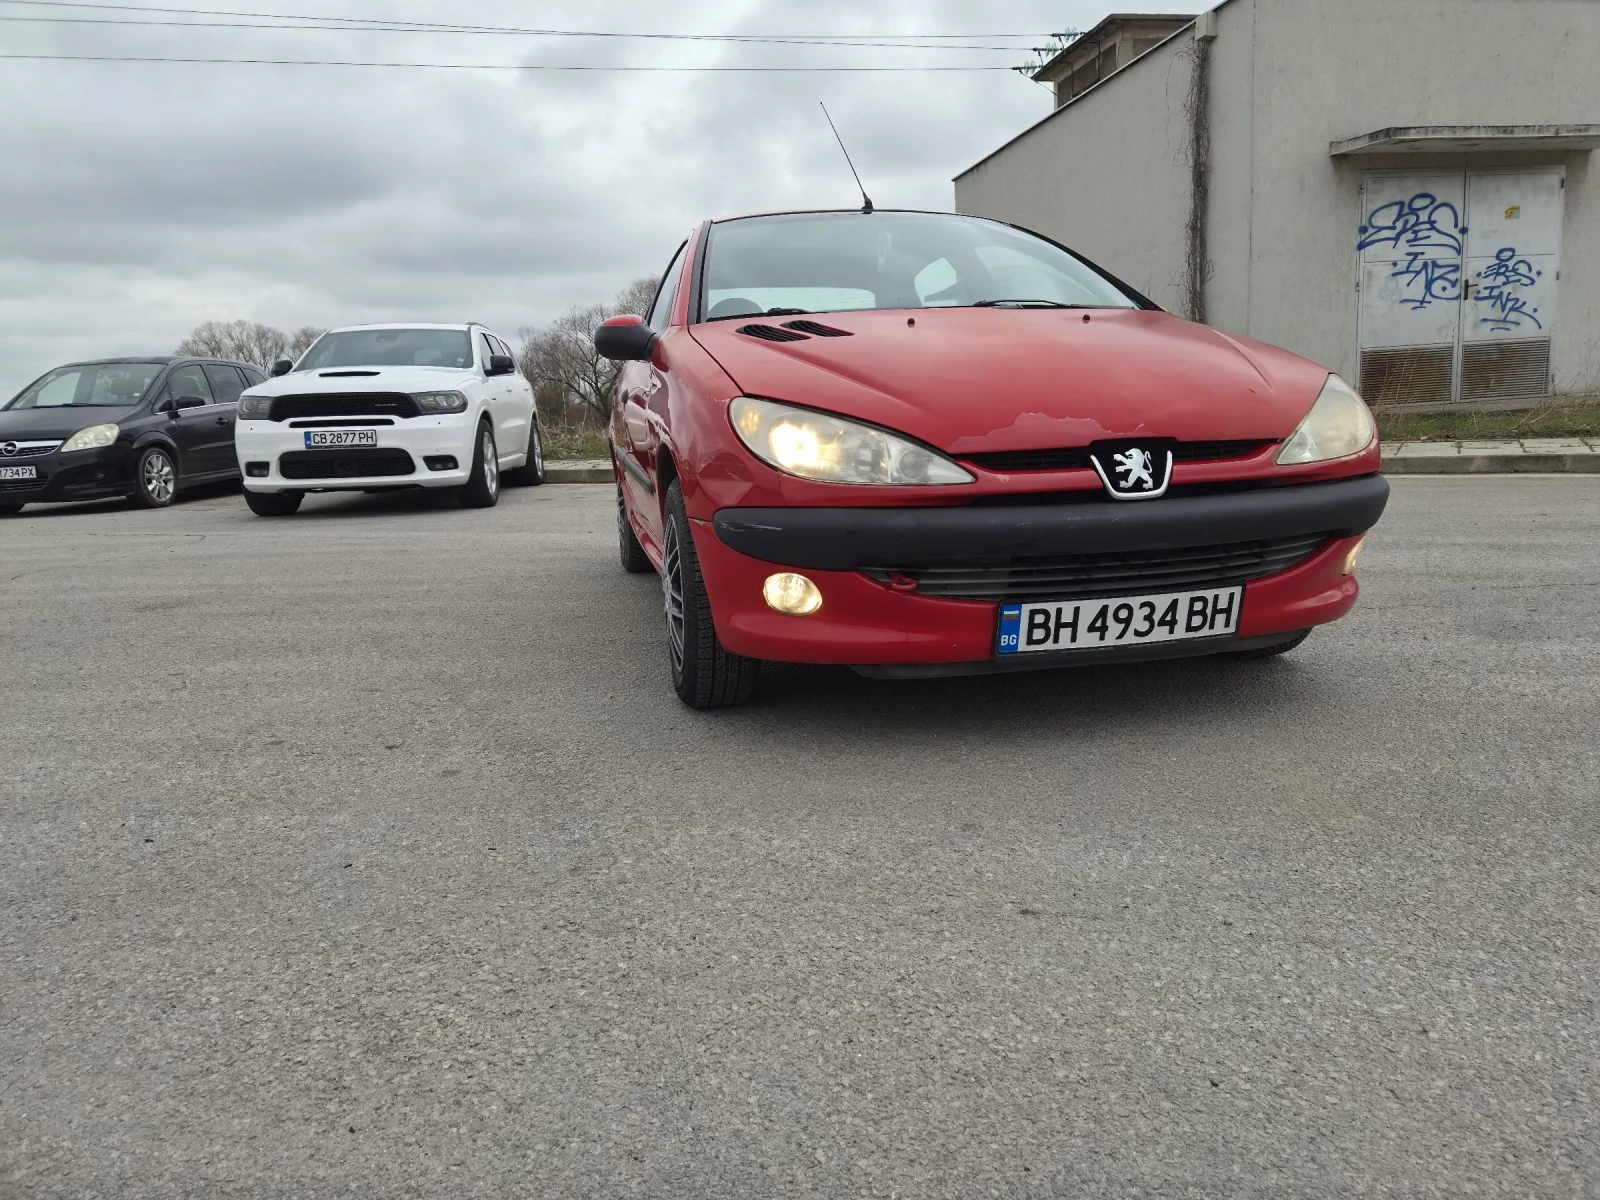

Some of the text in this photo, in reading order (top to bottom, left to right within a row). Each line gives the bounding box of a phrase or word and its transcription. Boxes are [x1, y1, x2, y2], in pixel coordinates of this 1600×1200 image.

[312, 433, 327, 444] CB
[329, 432, 357, 444] 2877
[358, 431, 374, 443] PH
[21, 467, 34, 477] PX
[1025, 591, 1236, 646] BH 4934 BH
[1000, 634, 1017, 646] BG
